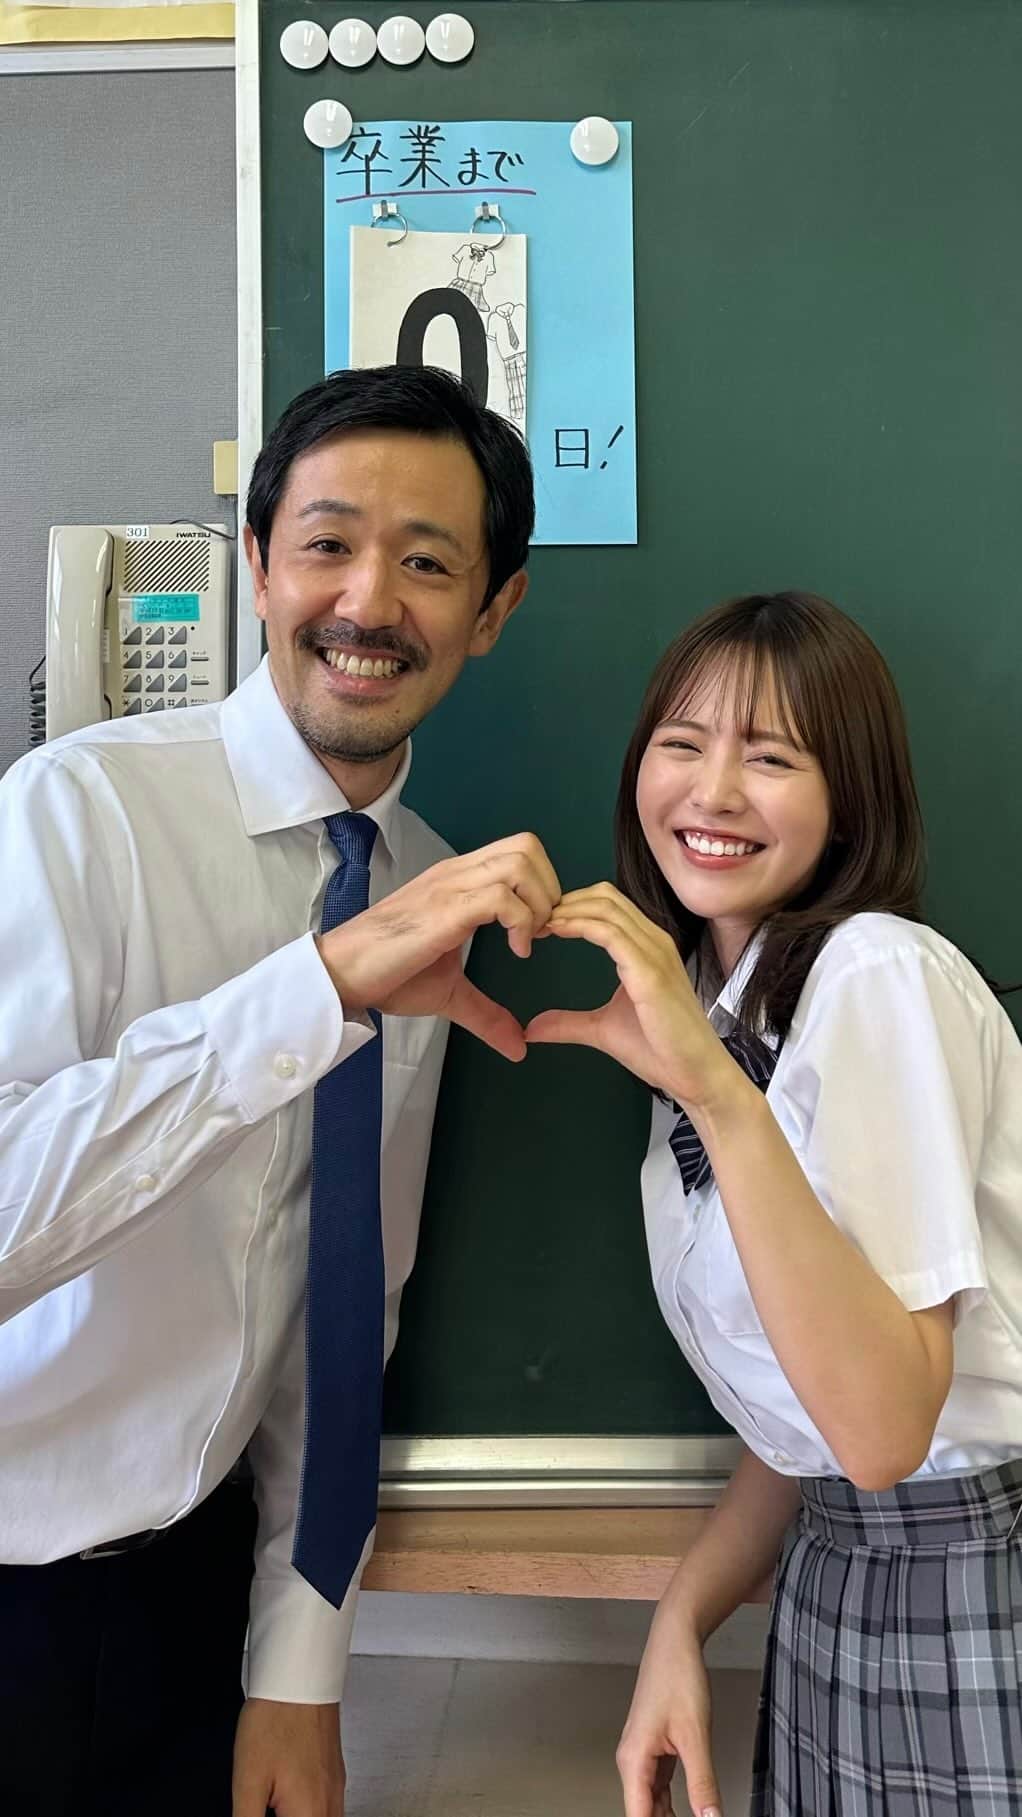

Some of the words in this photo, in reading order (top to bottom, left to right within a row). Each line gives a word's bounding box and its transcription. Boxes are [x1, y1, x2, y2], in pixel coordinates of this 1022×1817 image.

[336, 124, 526, 196] 卒業まで
[127, 528, 148, 537] 301
